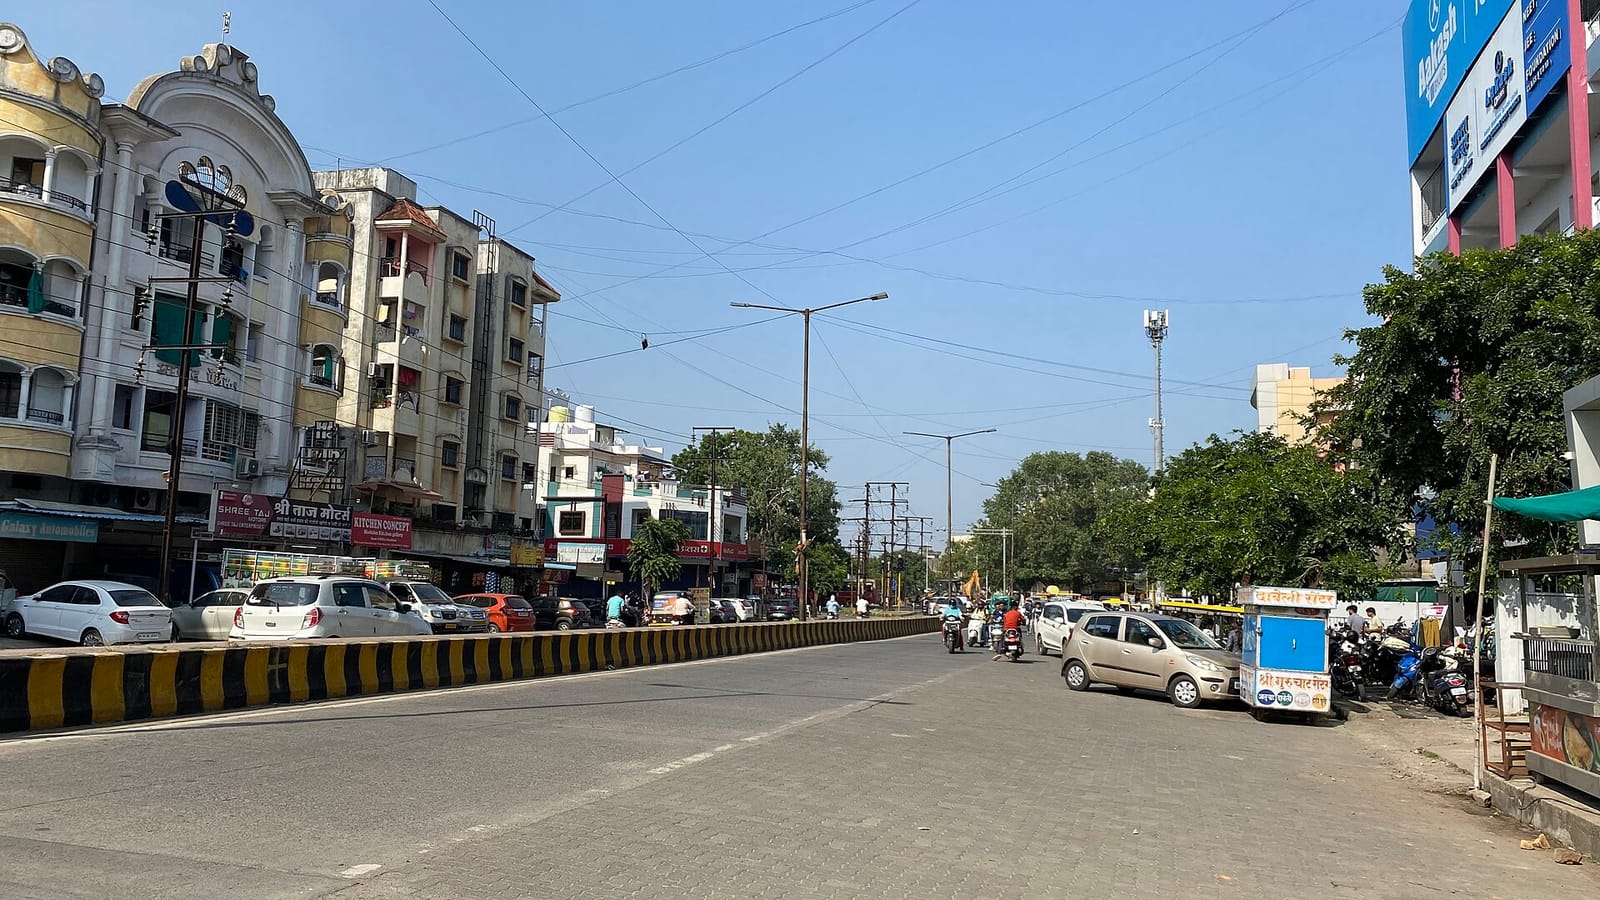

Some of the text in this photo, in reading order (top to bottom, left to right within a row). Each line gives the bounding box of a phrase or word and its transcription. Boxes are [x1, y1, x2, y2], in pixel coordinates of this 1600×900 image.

[1419, 2, 1456, 98] Aakash
[218, 505, 270, 517] SHREE TAJ
[274, 499, 352, 521] श्री ताज मोटर्स
[354, 517, 383, 529] KITCHEN
[383, 520, 410, 532] CONCEPT
[1259, 673, 1273, 686] श्री
[1293, 678, 1311, 688] चाट
